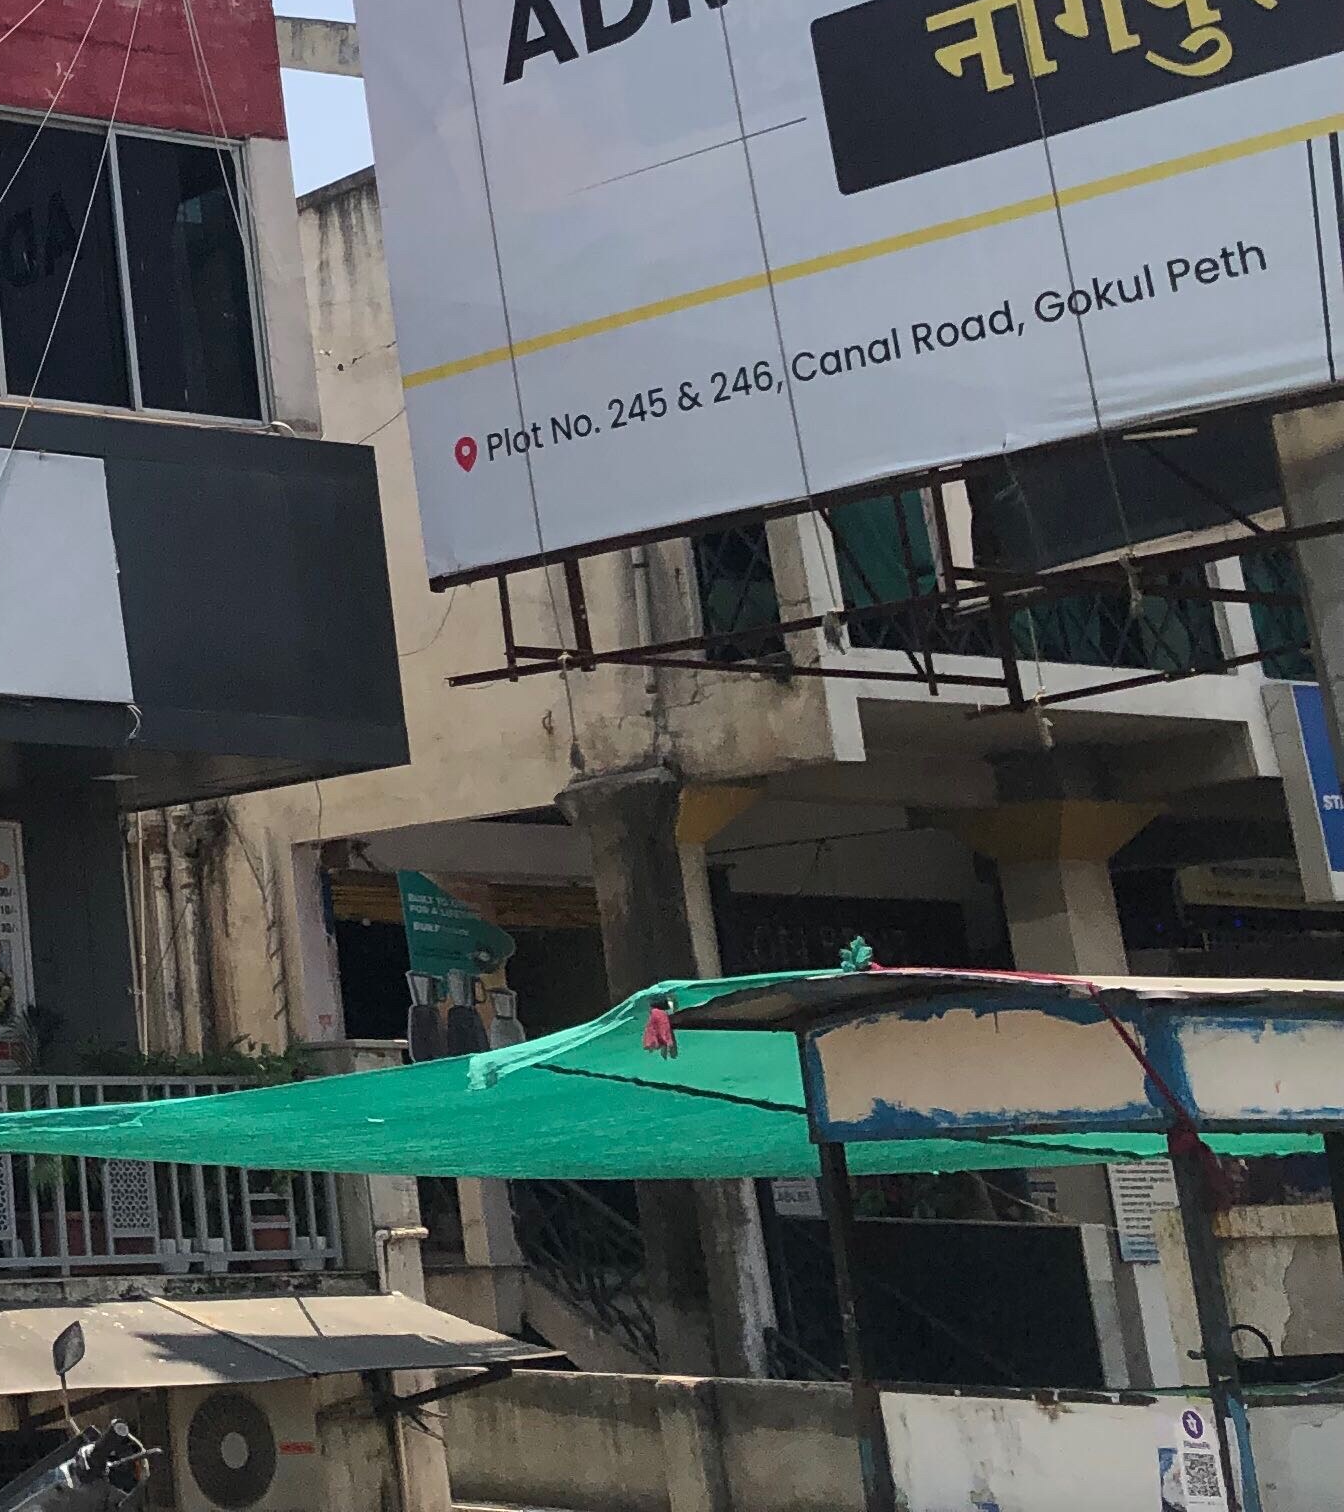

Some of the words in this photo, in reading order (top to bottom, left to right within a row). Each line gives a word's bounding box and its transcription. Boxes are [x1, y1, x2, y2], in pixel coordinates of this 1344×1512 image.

[486, 423, 544, 462] Plot
[550, 411, 601, 444] No.
[607, 387, 668, 430] 245
[677, 381, 703, 412] &
[710, 360, 784, 405] 246,
[791, 327, 902, 383] Canal
[911, 299, 1025, 355] Road,
[1034, 263, 1156, 323] Gokul
[1165, 240, 1268, 293] Peth
